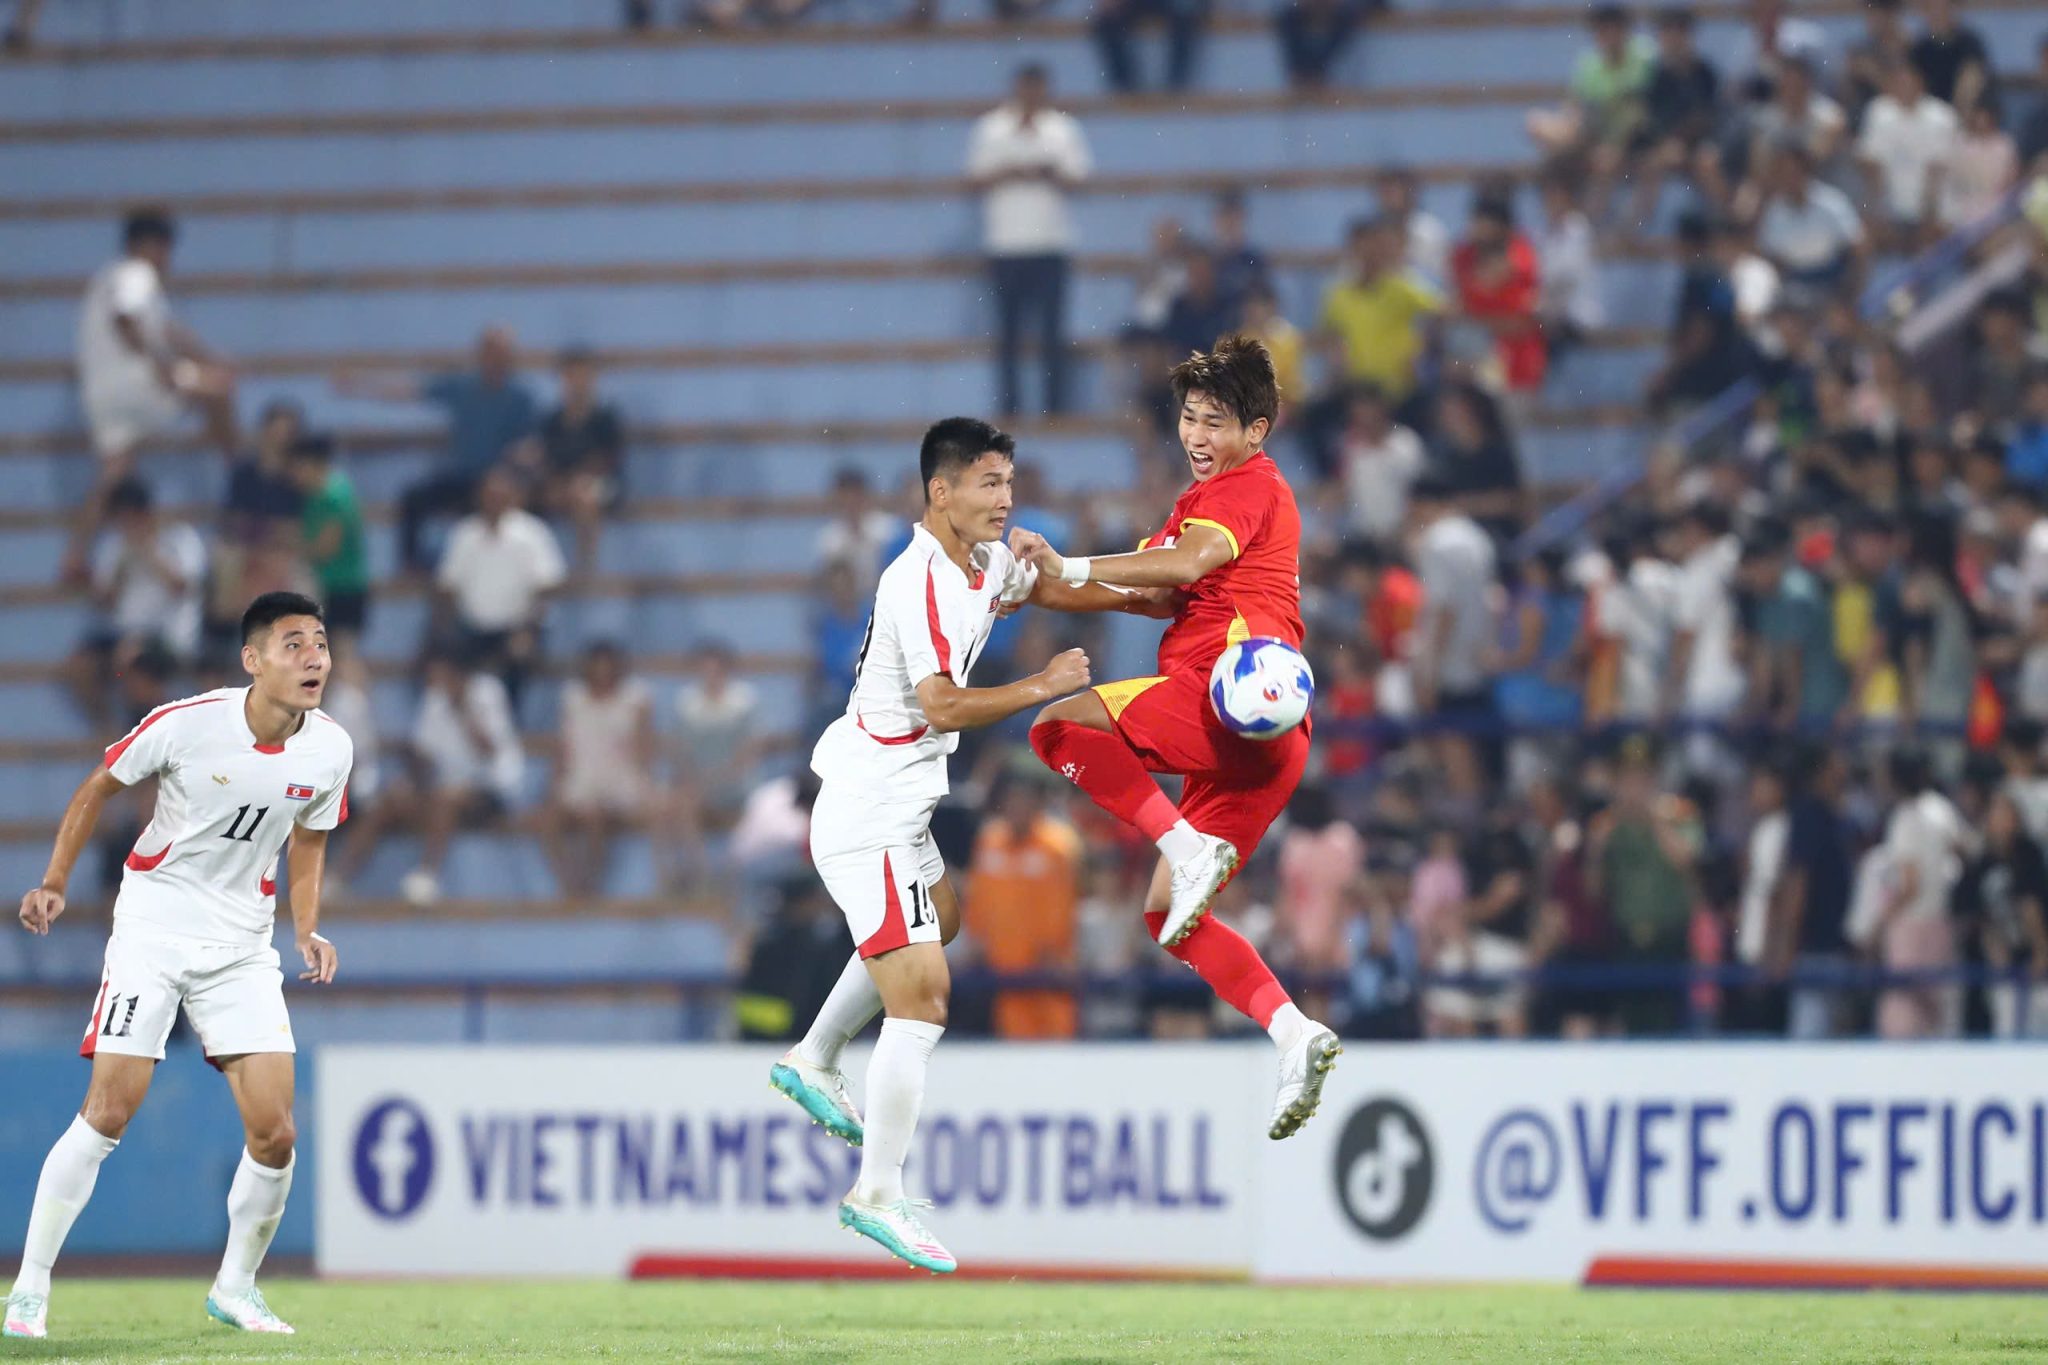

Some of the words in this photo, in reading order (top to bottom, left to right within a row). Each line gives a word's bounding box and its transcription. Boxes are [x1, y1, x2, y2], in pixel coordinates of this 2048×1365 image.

[219, 803, 270, 842] 11
[99, 992, 139, 1037] 11
[460, 1112, 1226, 1209] VIETNAMESOOTBALL
